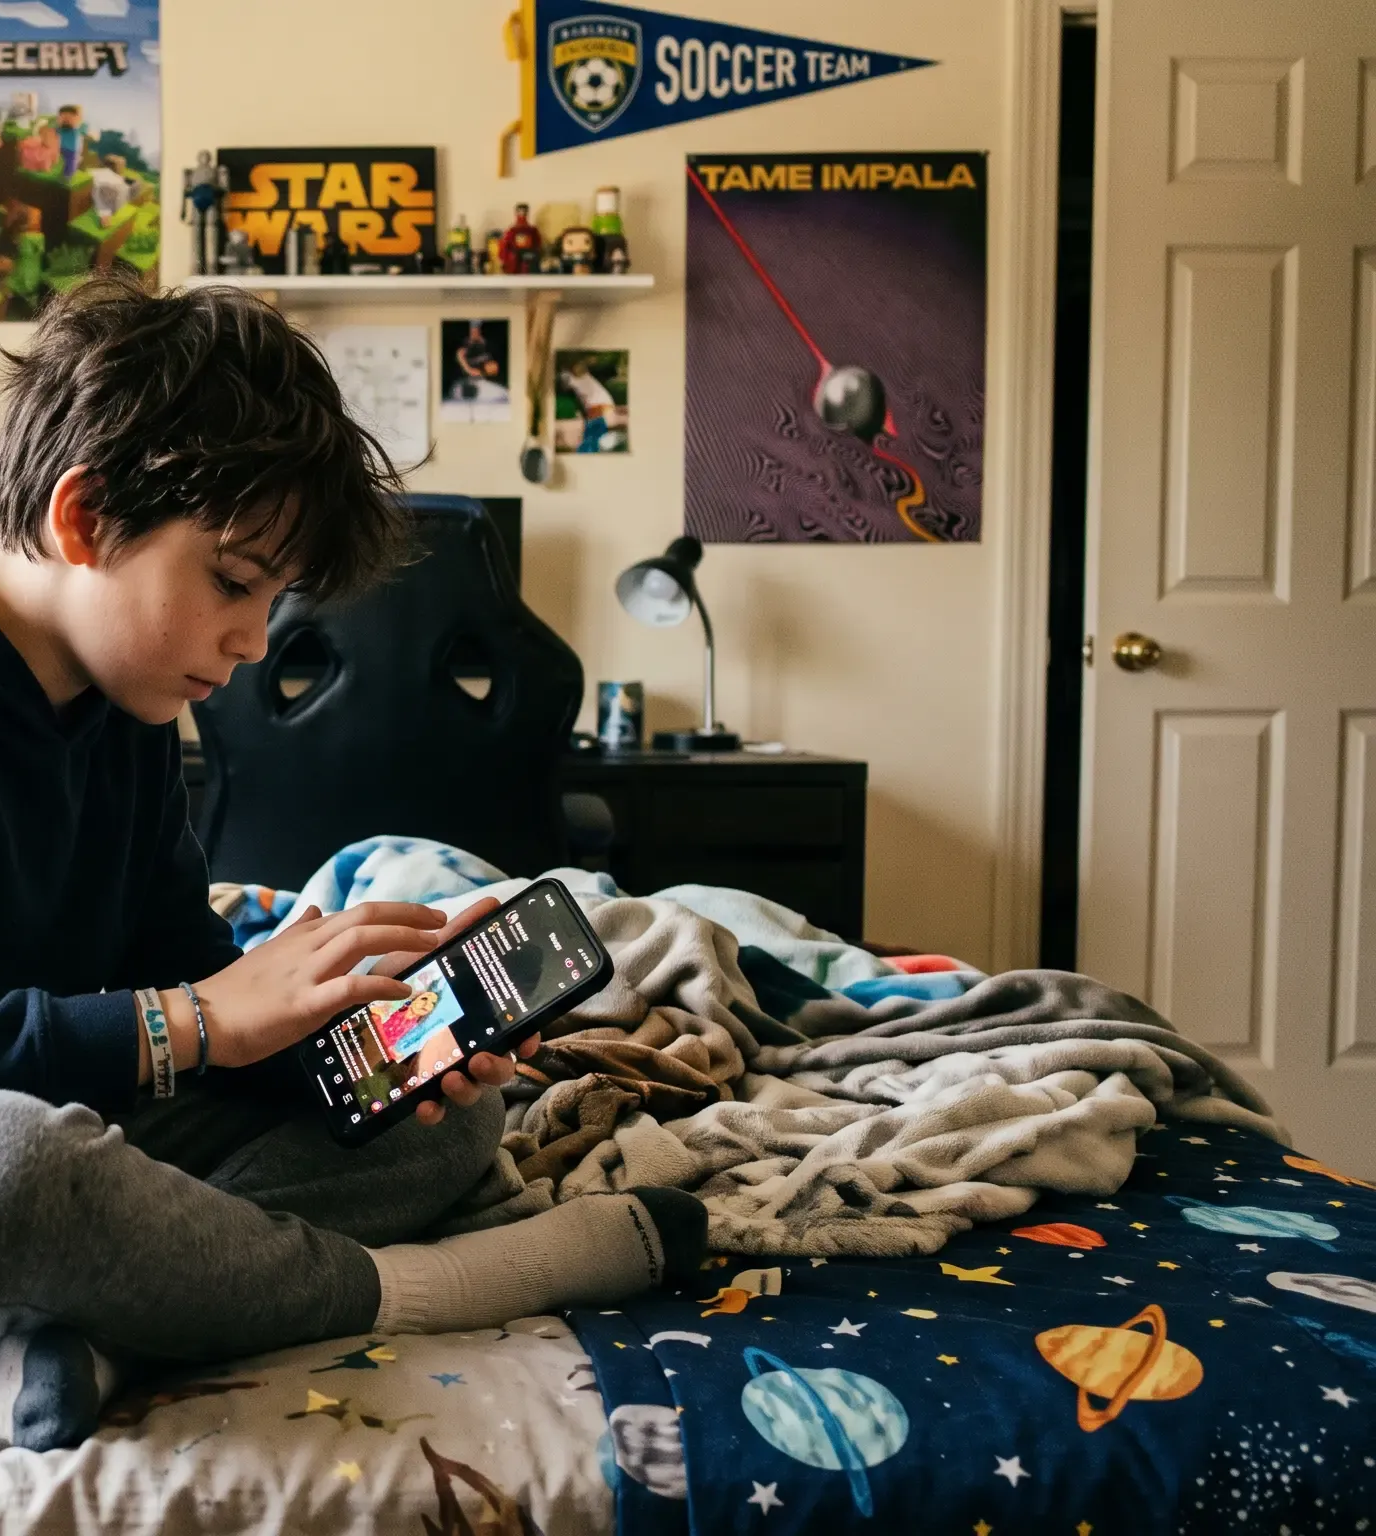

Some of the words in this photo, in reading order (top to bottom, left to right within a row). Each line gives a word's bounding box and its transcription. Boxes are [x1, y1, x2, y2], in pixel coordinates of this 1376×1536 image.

[655, 35, 797, 105] SOCCER
[803, 51, 871, 82] TEAM
[227, 162, 433, 208] STAR
[698, 164, 812, 191] TAME
[821, 164, 976, 191] IMPALA
[226, 209, 435, 256] WARS
